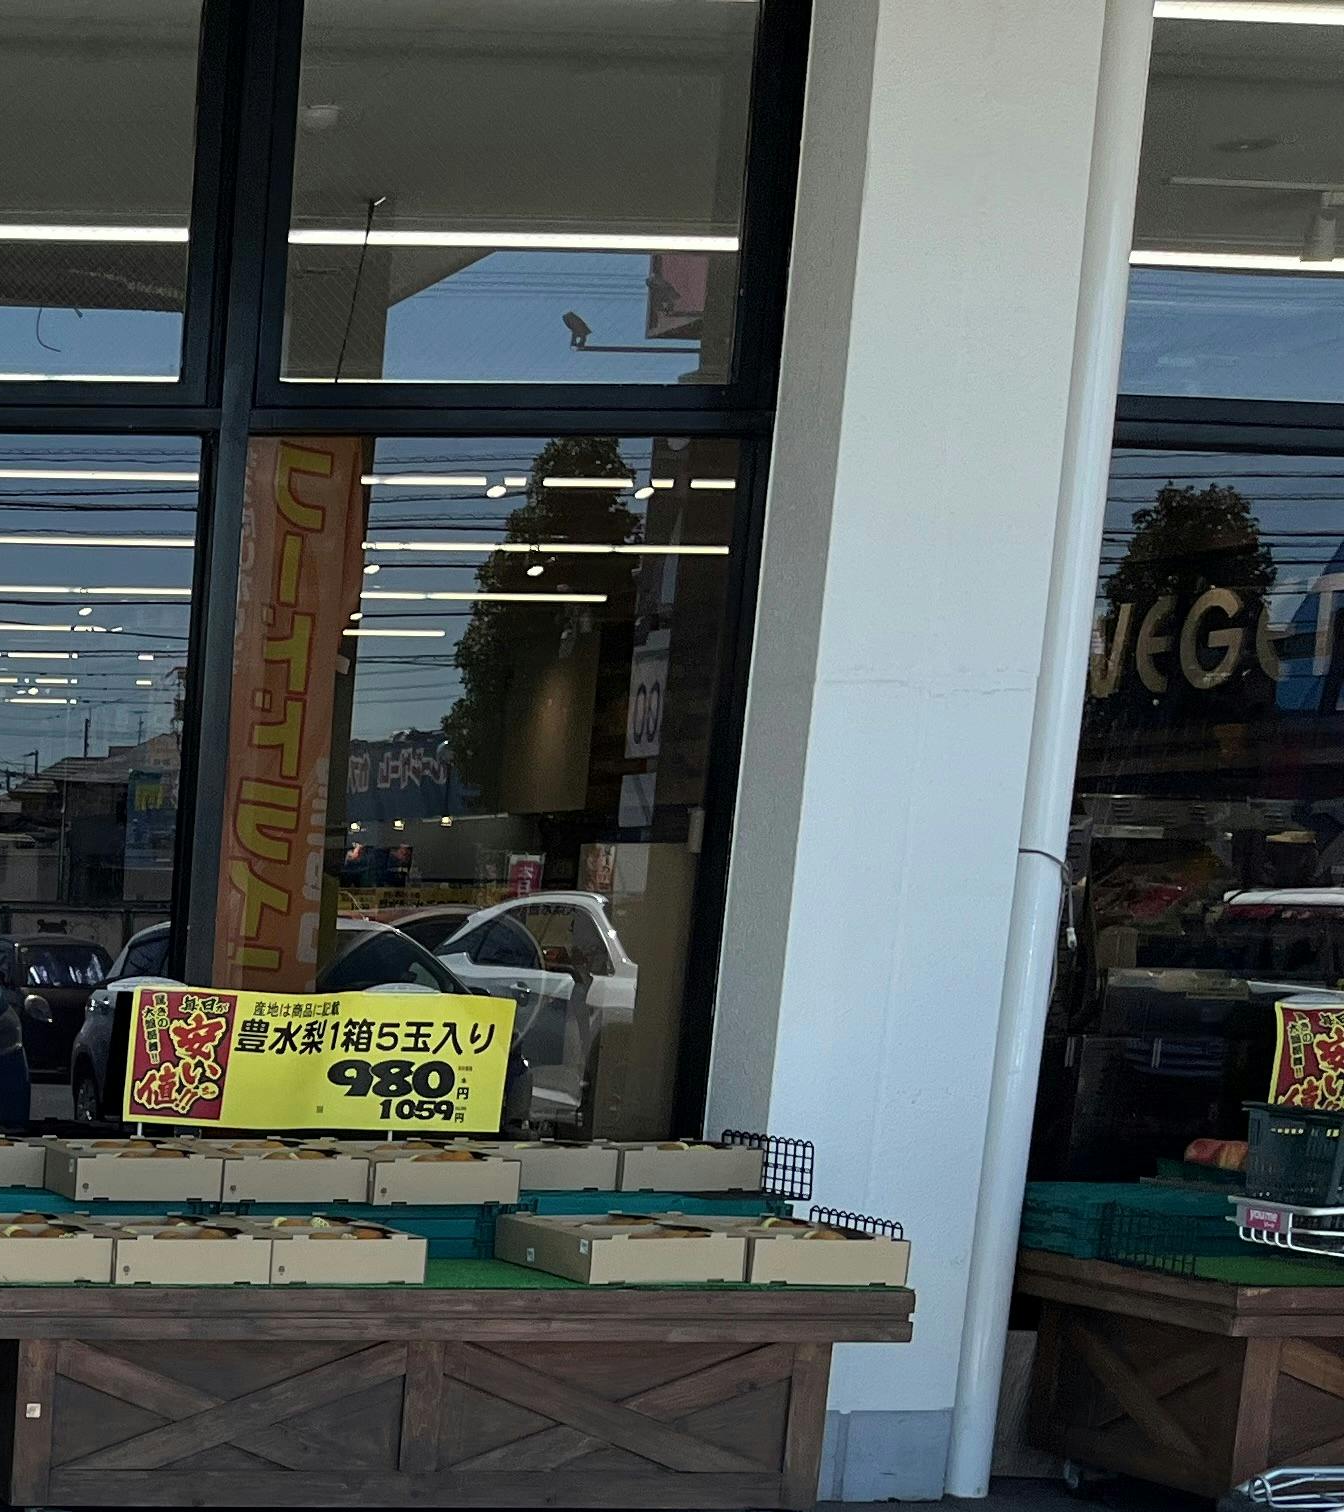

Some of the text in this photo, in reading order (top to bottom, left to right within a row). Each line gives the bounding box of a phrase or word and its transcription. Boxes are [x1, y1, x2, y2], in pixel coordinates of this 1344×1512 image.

[253, 1000, 340, 1018] 産地は商品に記載
[234, 1018, 496, 1055] 豊水梨1箱5玉入り
[327, 1059, 455, 1098] 980
[379, 1099, 454, 1120] 1059
